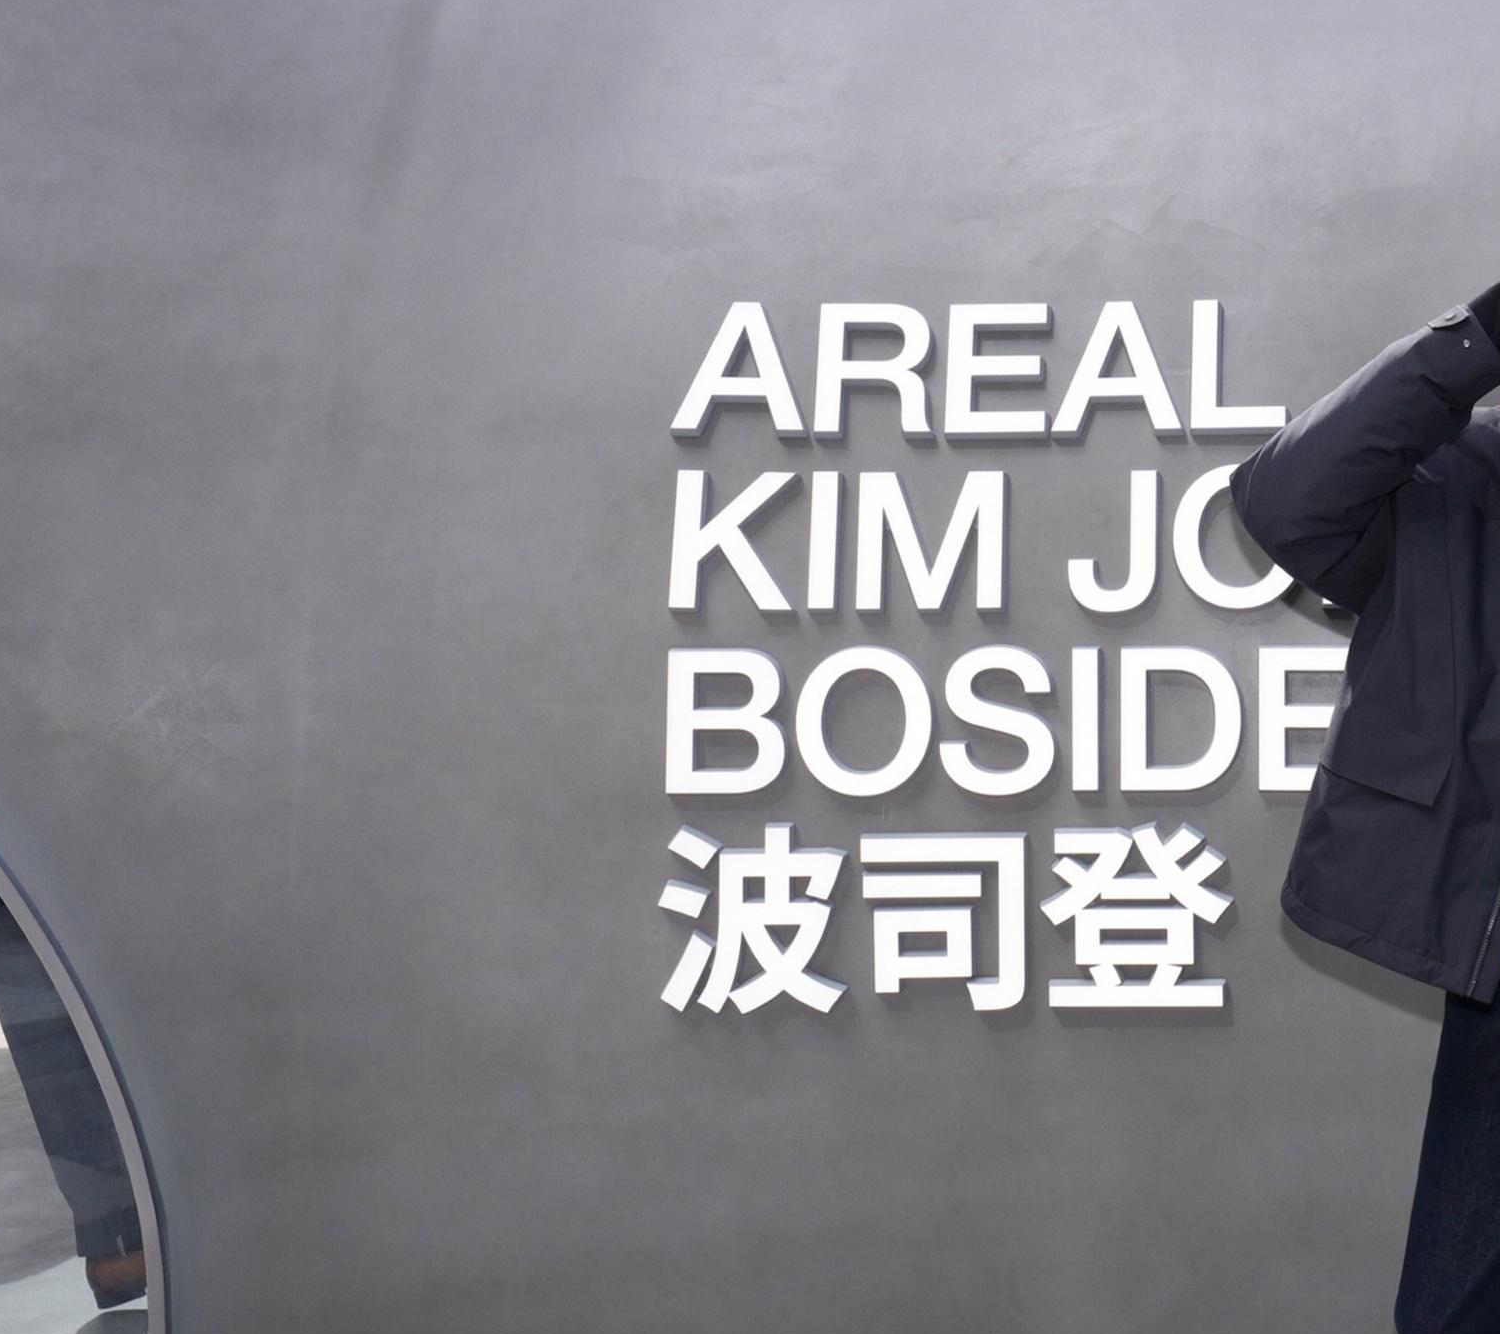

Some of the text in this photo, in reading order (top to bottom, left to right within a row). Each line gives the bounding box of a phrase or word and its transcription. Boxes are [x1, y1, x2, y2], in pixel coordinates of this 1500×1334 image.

[669, 299, 1291, 440] AREAL
[667, 464, 1342, 615] KIM JO
[664, 644, 1350, 797] BOSIDE
[657, 820, 1236, 1015] 波司登
